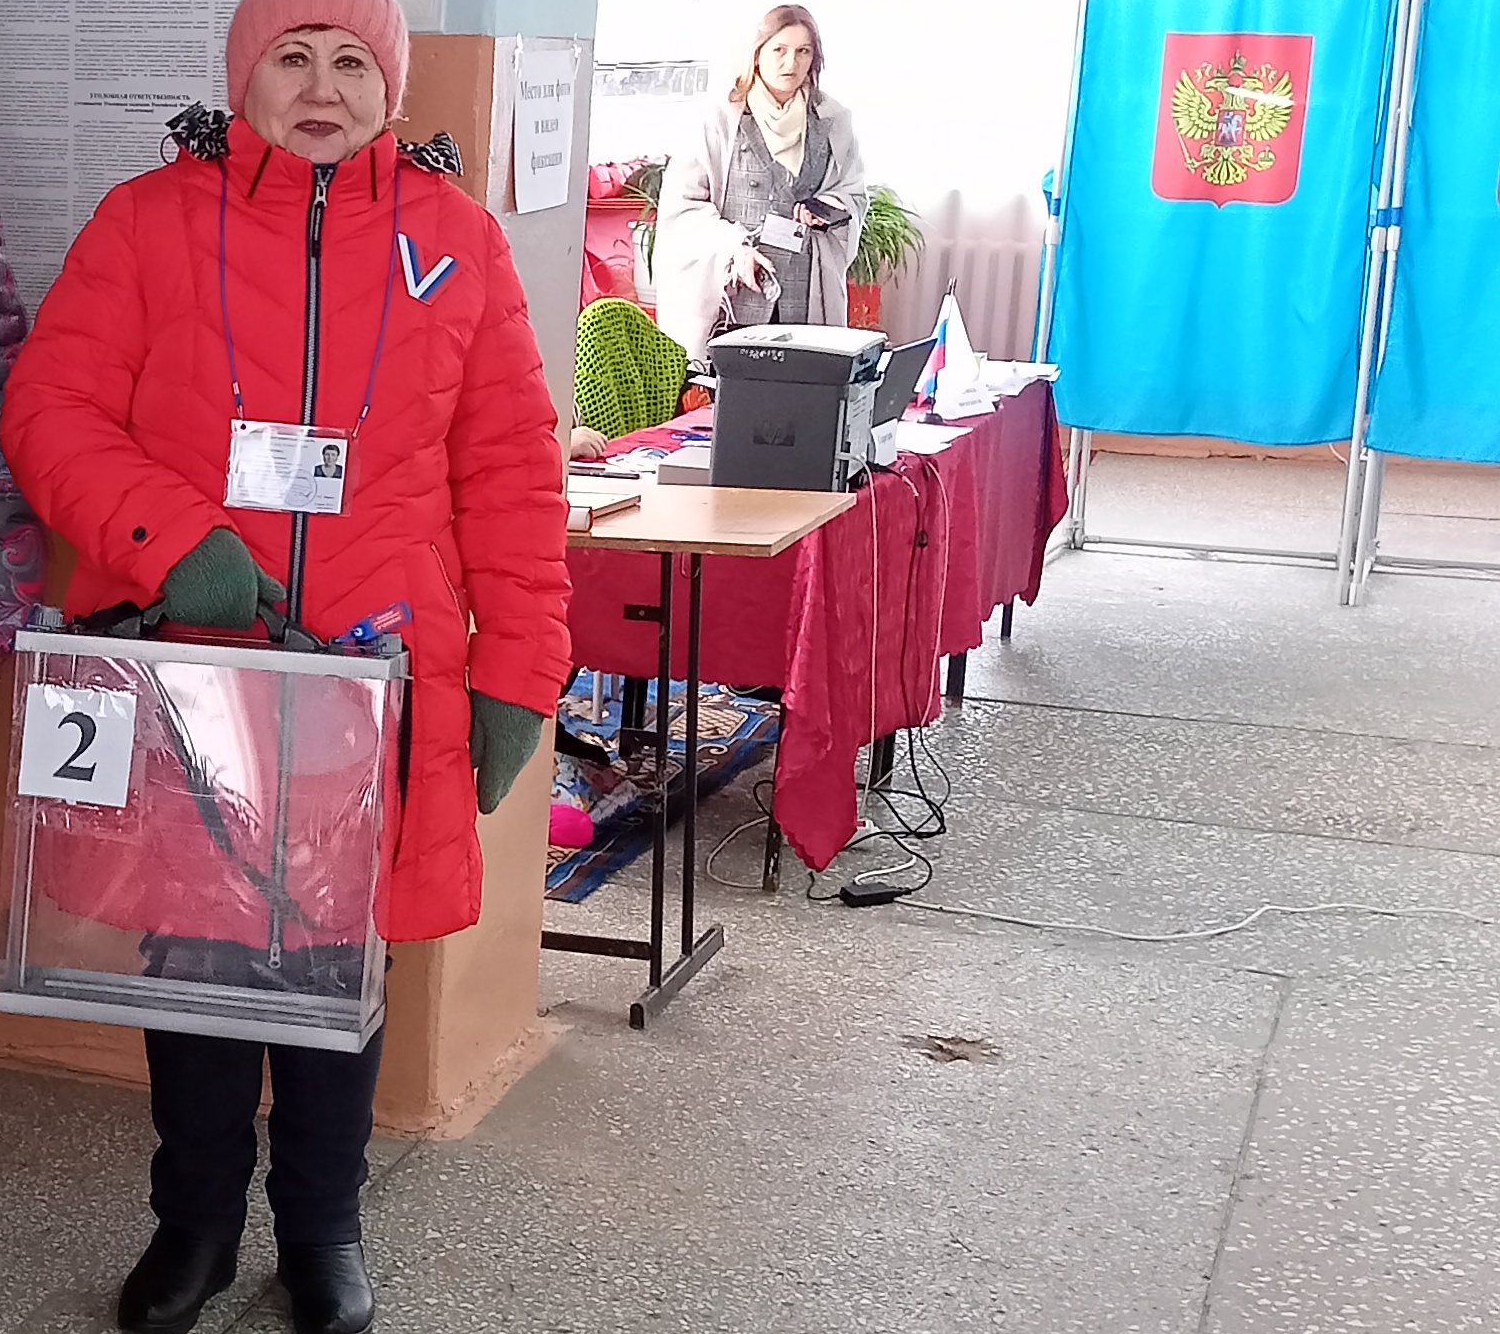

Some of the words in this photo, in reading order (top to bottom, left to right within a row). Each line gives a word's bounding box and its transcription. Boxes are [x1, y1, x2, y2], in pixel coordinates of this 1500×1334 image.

[520, 80, 541, 100] Место
[556, 78, 570, 102] фото
[52, 711, 98, 783] 2
